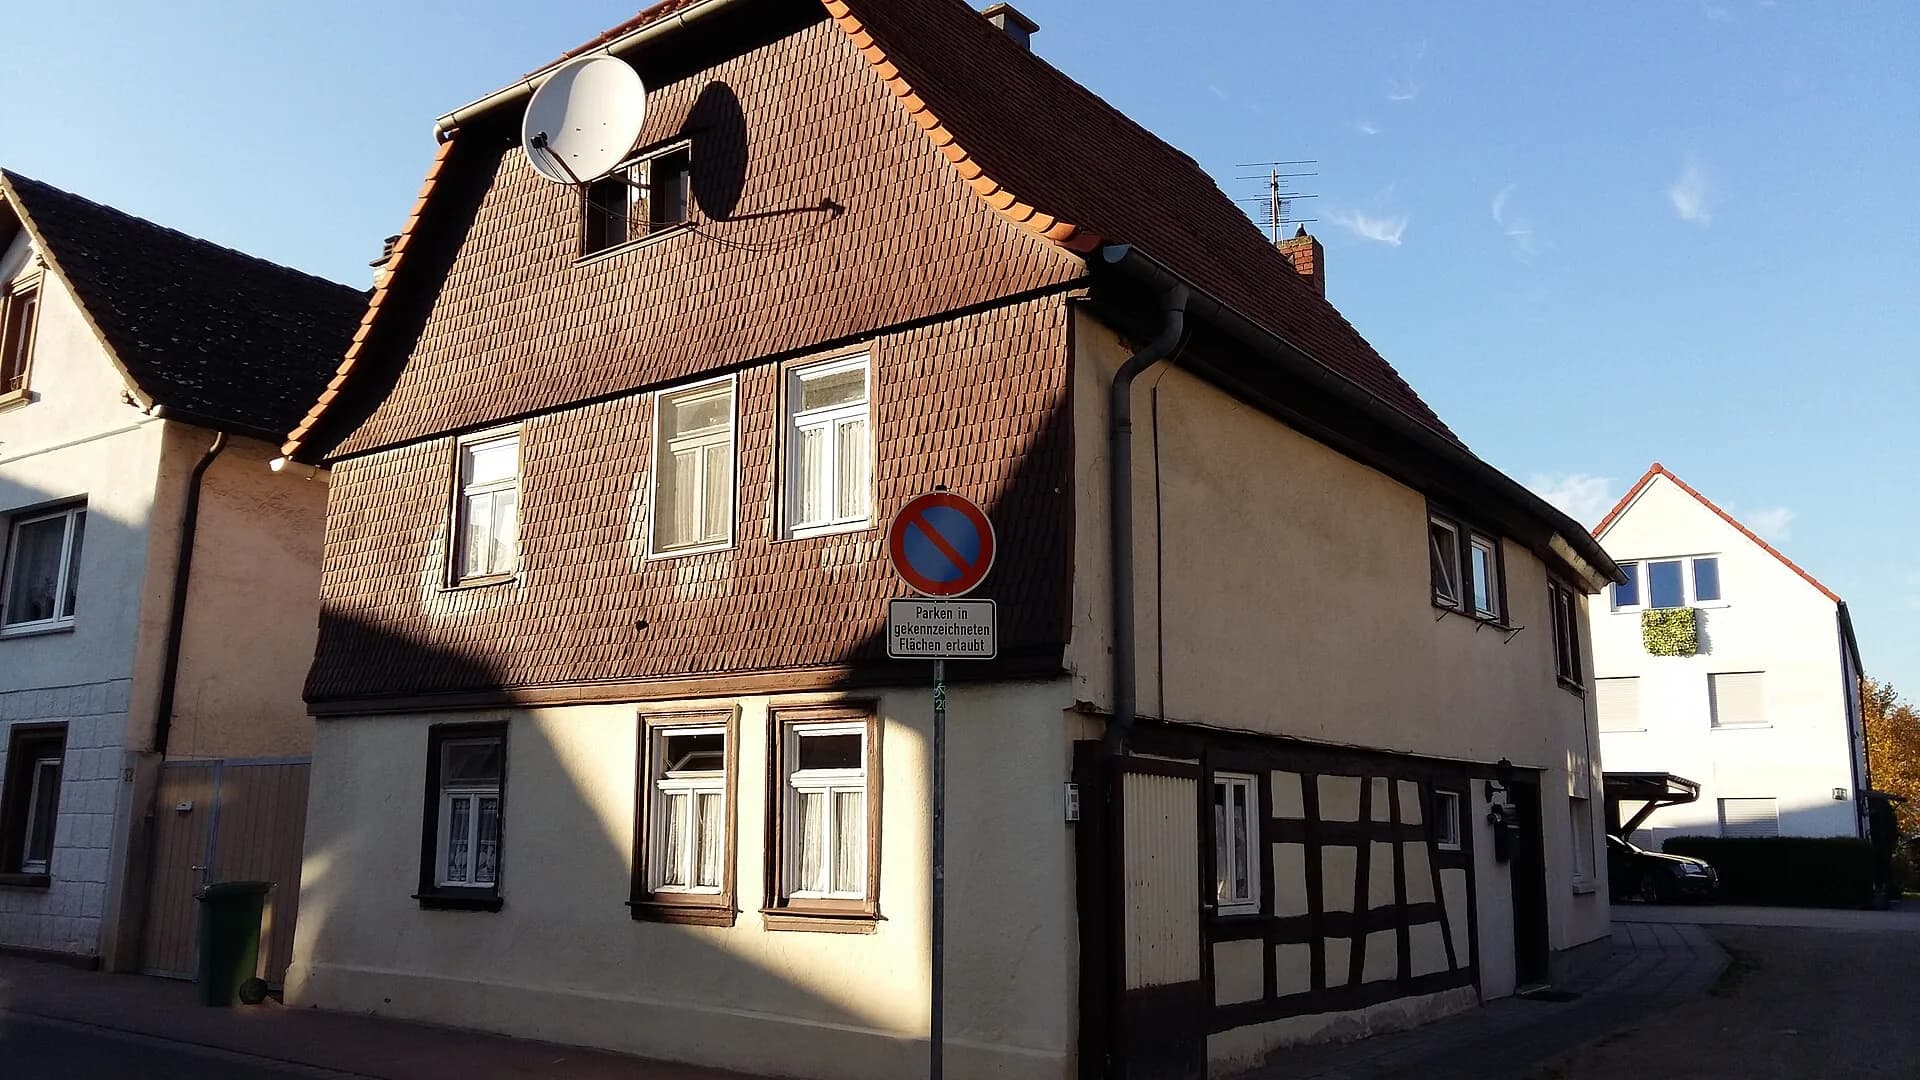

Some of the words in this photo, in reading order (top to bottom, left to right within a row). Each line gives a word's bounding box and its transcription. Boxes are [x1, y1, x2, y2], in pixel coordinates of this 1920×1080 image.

[916, 606, 953, 620] Parken
[958, 607, 968, 620] in
[894, 622, 990, 638] gekennzeichneten
[899, 637, 941, 651] Flächen
[946, 638, 985, 652] erlaubt
